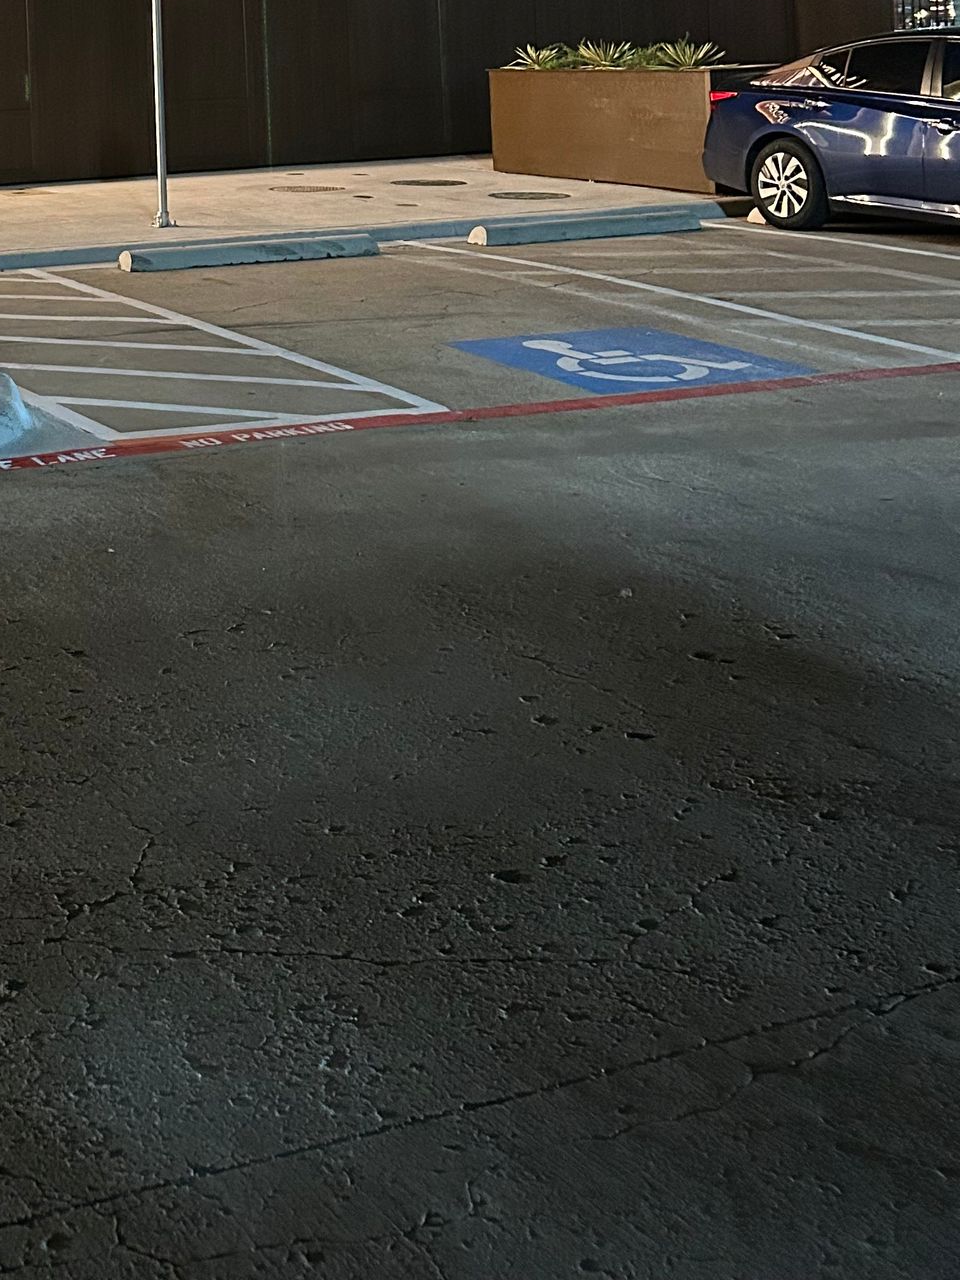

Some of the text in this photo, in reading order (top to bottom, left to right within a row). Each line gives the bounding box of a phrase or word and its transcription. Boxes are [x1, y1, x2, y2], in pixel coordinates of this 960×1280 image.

[31, 448, 116, 466] LANE
[180, 436, 222, 449] NO
[232, 421, 355, 442] PARKING
